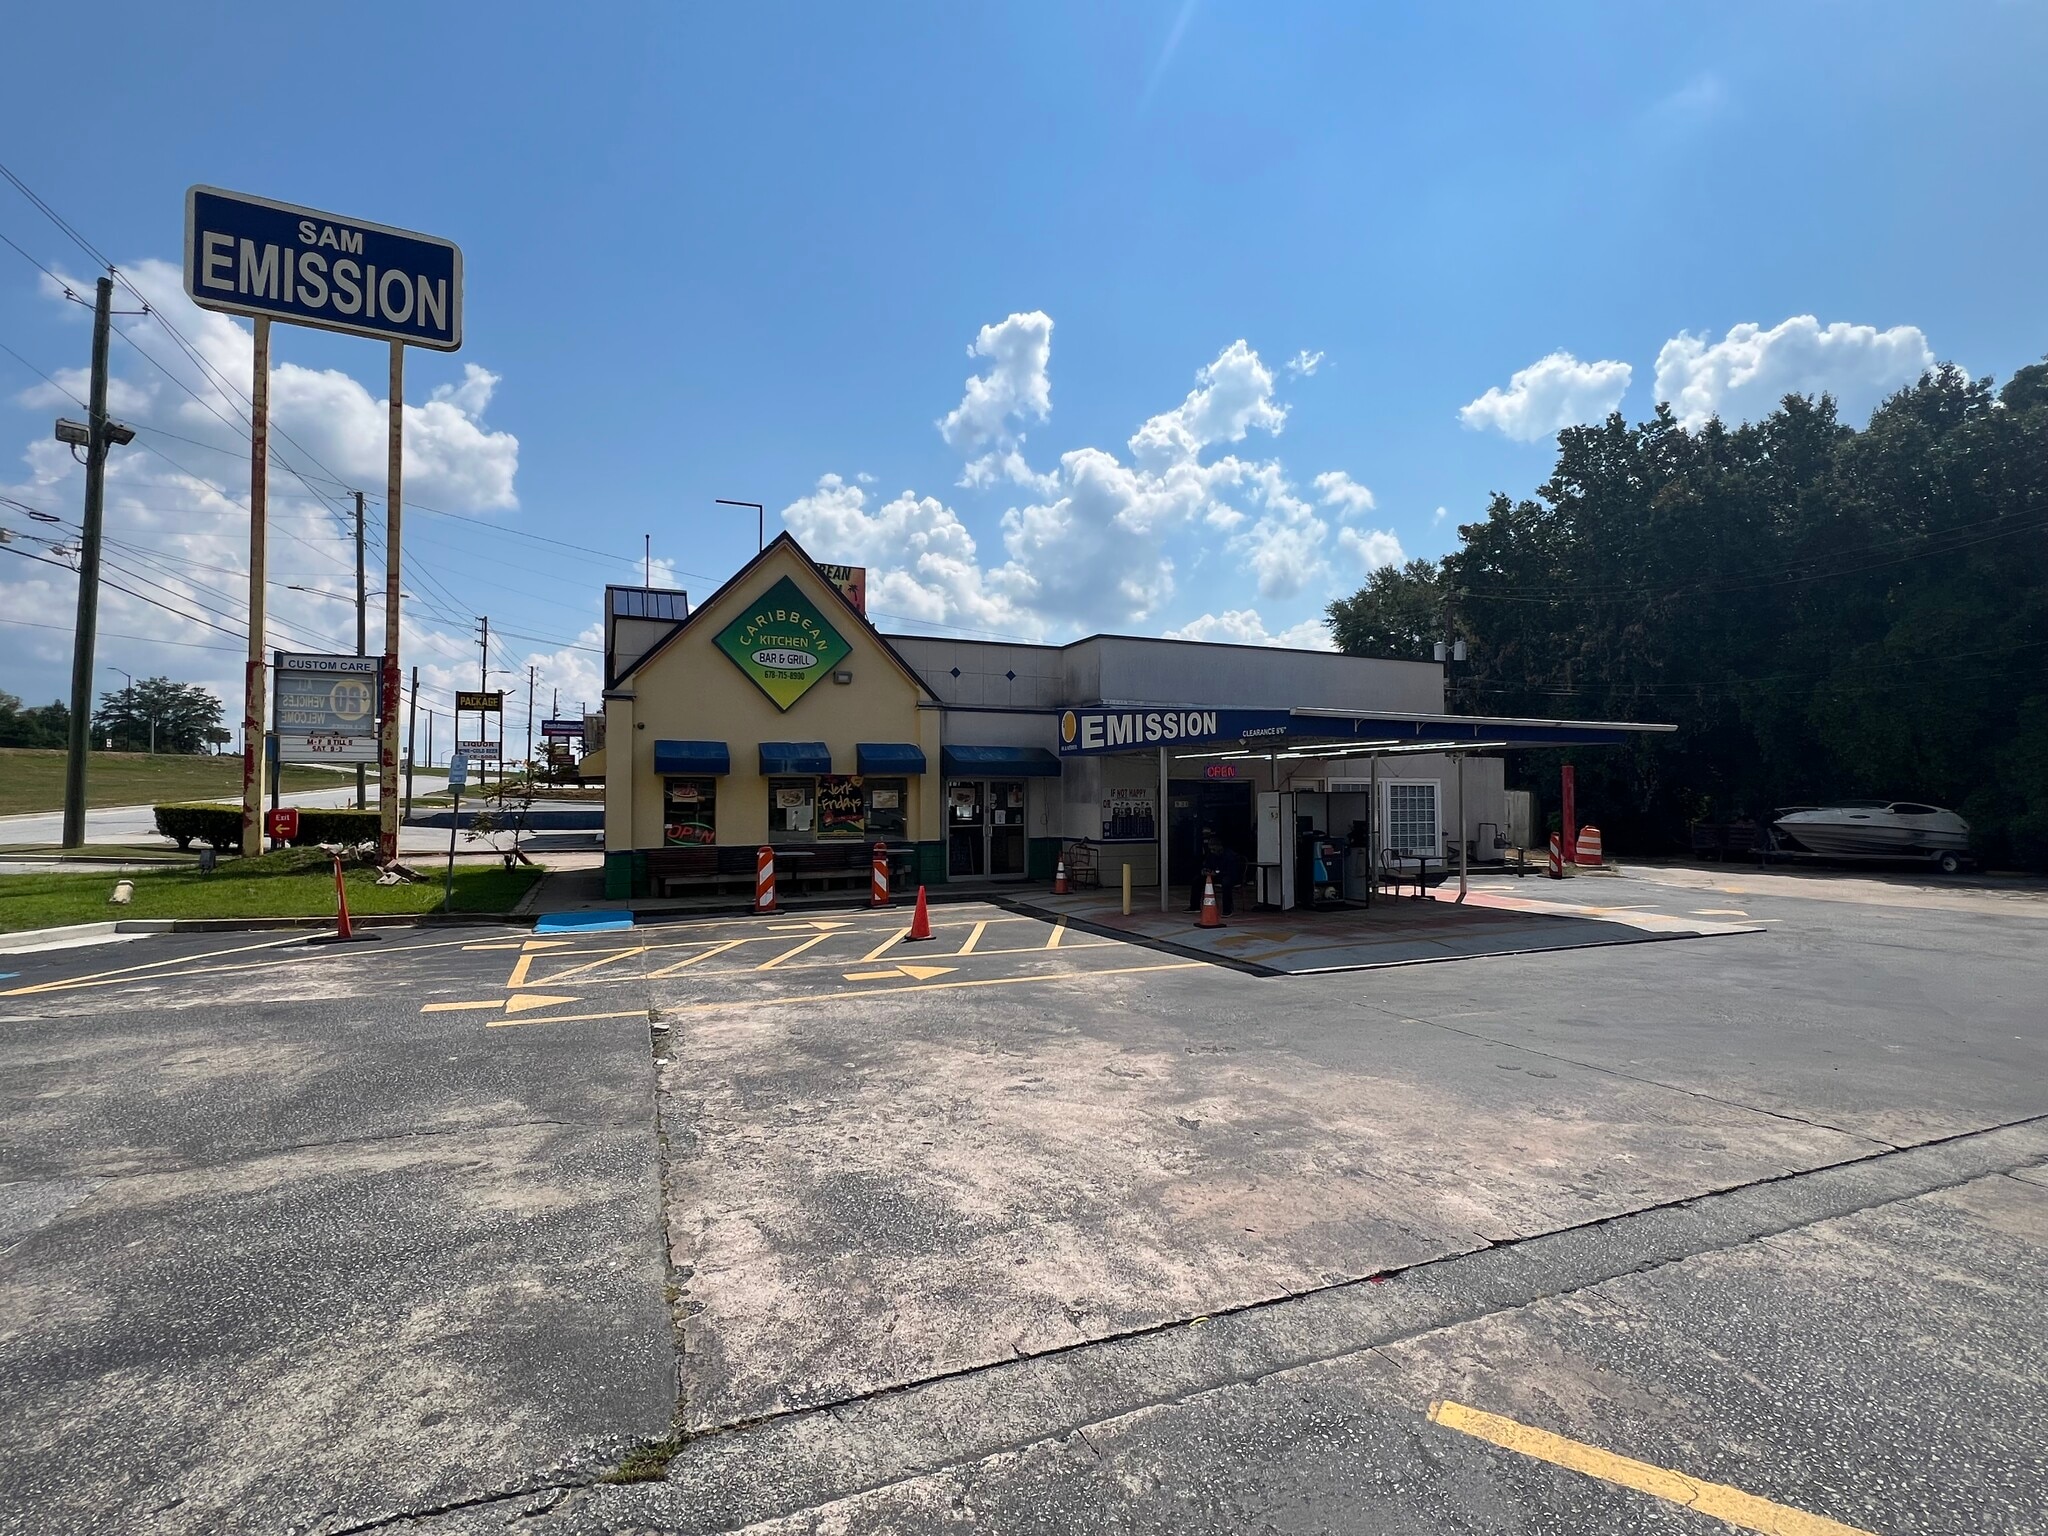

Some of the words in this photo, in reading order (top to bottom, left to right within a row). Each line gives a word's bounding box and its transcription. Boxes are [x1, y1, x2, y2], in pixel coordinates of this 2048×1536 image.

[298, 220, 363, 255] SAM
[202, 230, 446, 331] EMISSION
[739, 609, 828, 651] CARIBBEAN
[759, 634, 809, 648] KITCHEN
[288, 659, 337, 670] CUSTOM
[340, 662, 371, 671] CARE
[759, 652, 777, 663] BAR
[779, 653, 785, 664] &
[787, 654, 810, 665] GRILL
[460, 696, 499, 707] PACKAGE
[1081, 711, 1217, 749] EMISSION
[1242, 727, 1276, 738] CLEARANCE
[1207, 766, 1235, 778] OPEN
[824, 781, 854, 795] Jerk
[821, 795, 862, 813] Fridays
[275, 813, 291, 821] Exit
[667, 825, 715, 844] OPN
